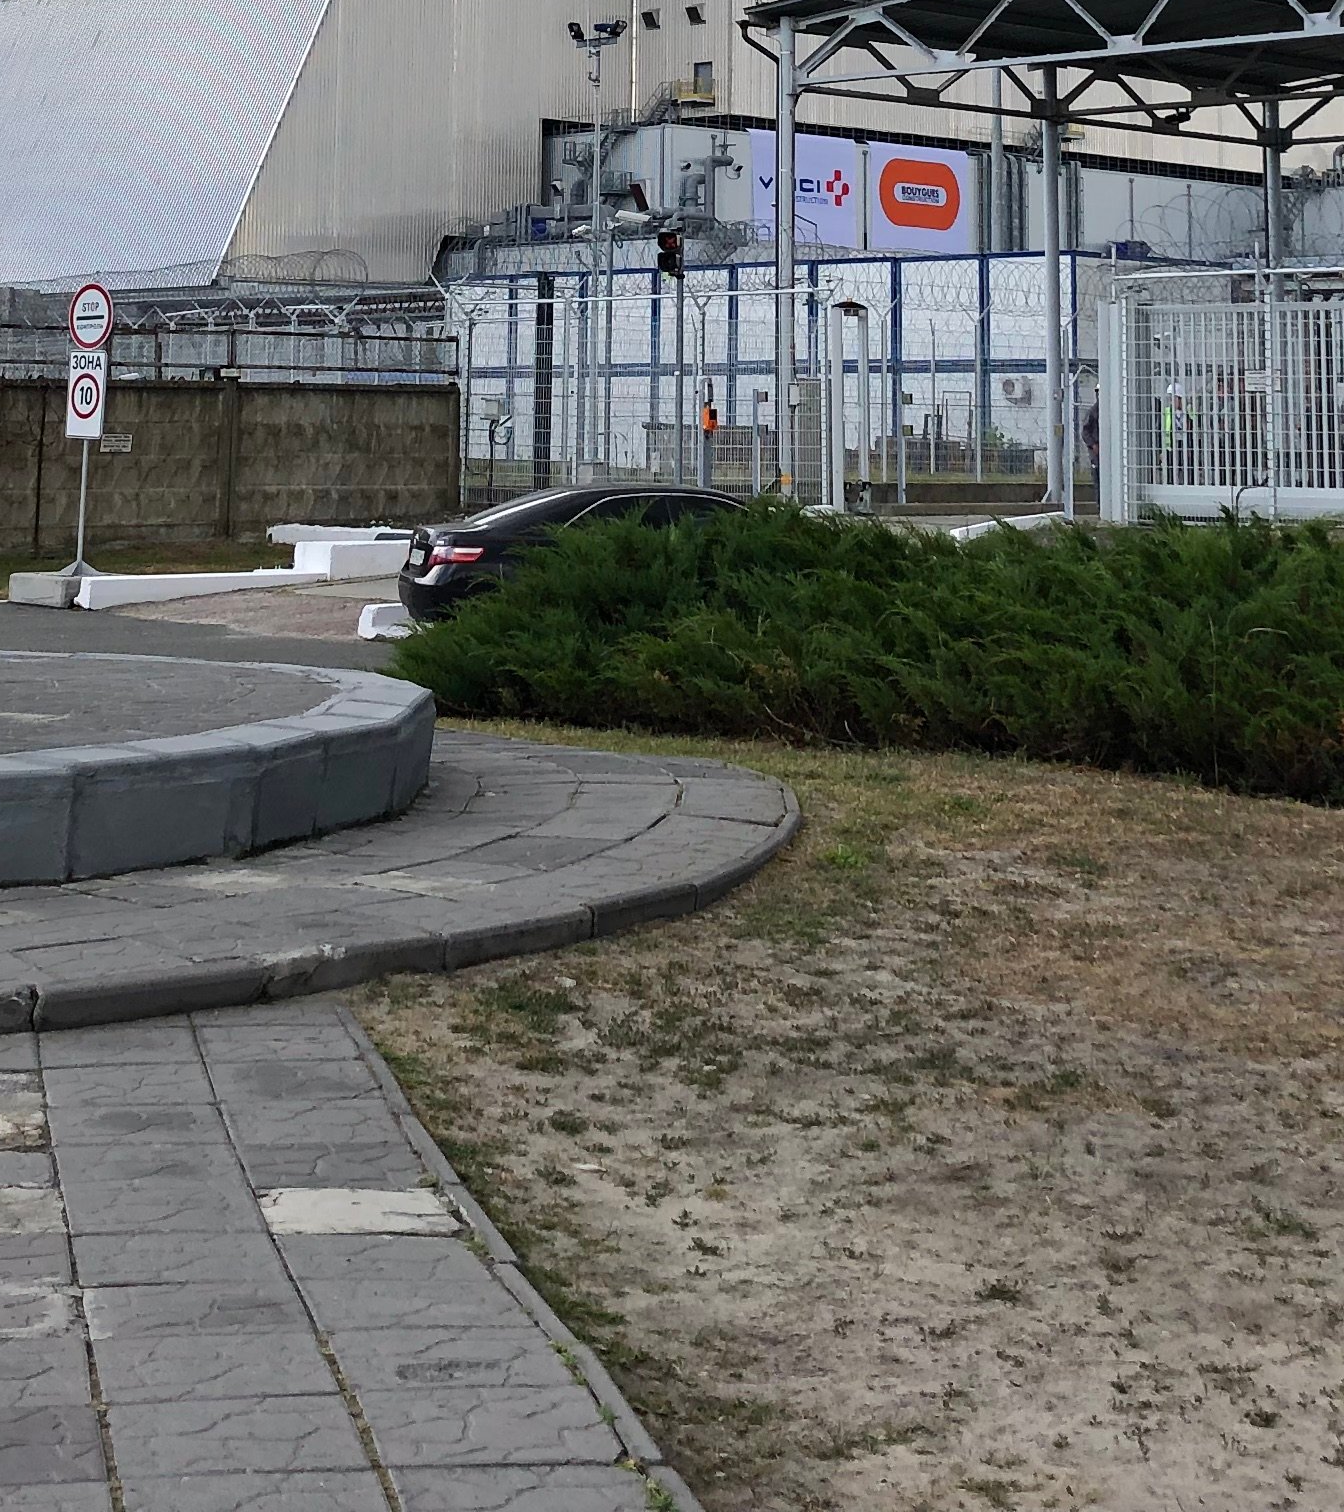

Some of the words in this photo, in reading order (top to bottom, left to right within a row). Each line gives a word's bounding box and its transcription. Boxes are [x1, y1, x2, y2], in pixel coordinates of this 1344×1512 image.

[759, 175, 821, 193] VCI
[901, 186, 939, 199] BOUYGUES
[81, 302, 99, 312] STOP
[72, 354, 102, 370] ЗОНА
[79, 385, 93, 406] 10
